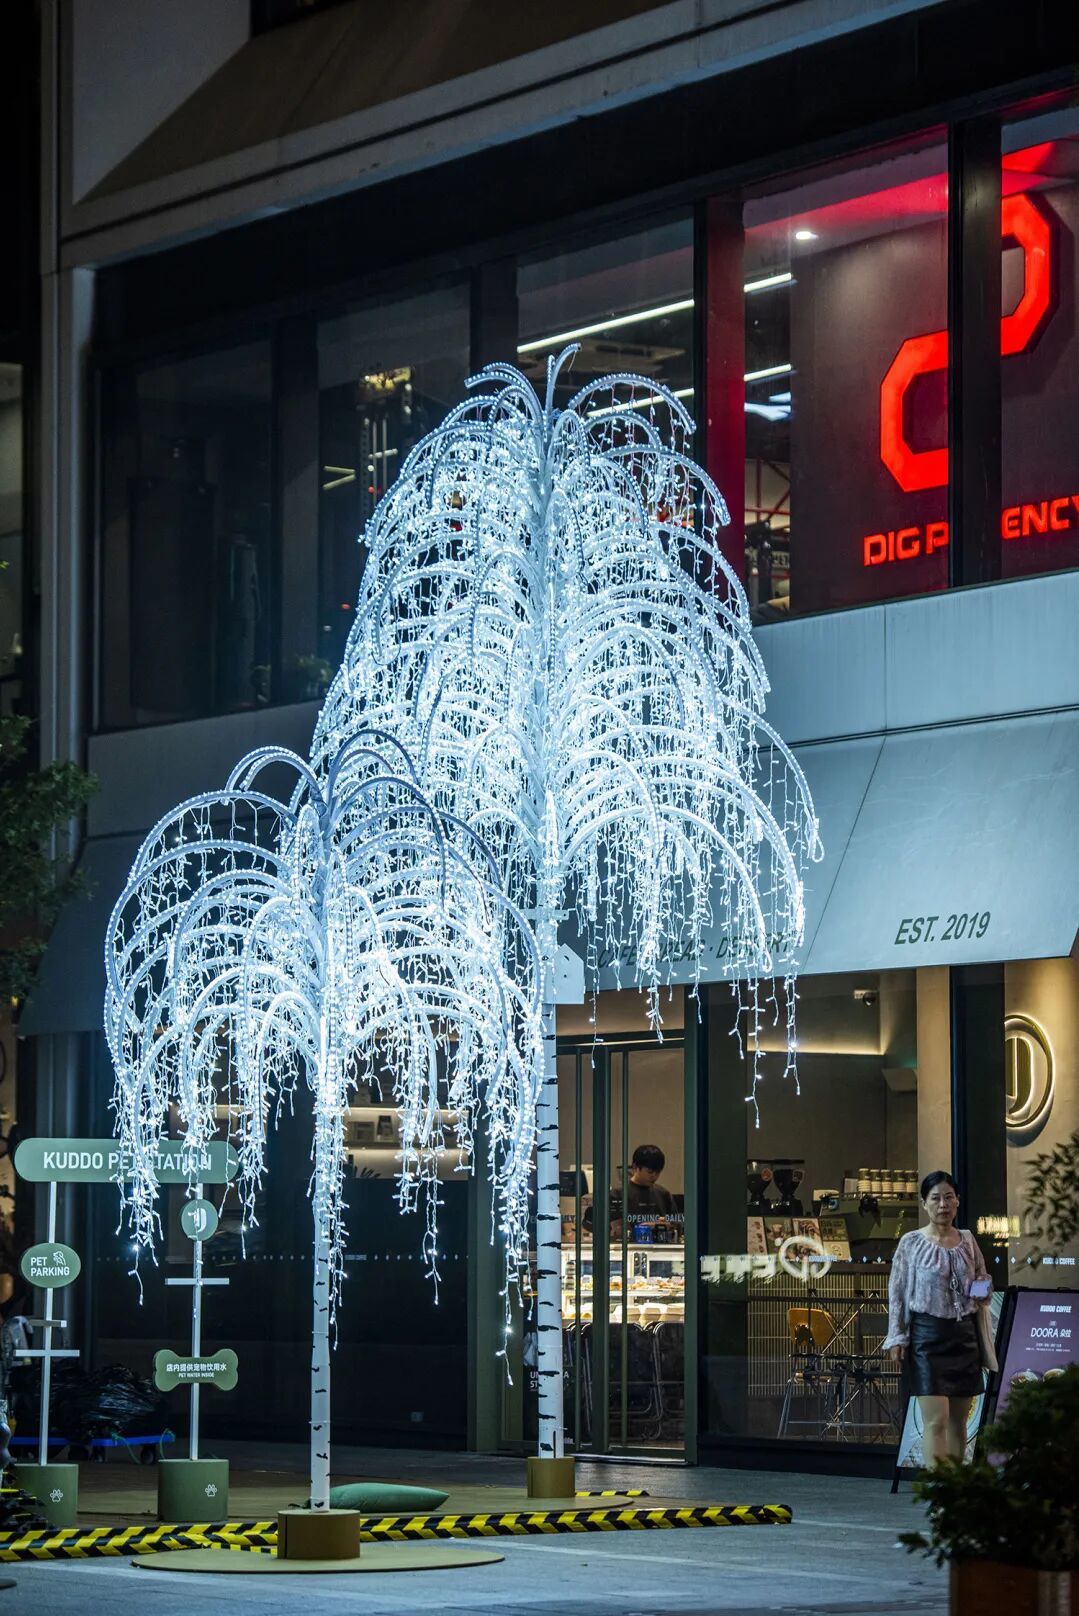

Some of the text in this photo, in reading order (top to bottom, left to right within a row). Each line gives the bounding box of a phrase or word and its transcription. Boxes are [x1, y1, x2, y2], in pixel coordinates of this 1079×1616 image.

[863, 526, 921, 567] DIG
[894, 911, 991, 945] EST. 2019
[43, 1151, 103, 1170] KUDDO
[143, 1153, 212, 1171] TATION
[30, 1256, 48, 1266] PET
[30, 1267, 70, 1277] PARKING
[1030, 1327, 1059, 1338] DOORA
